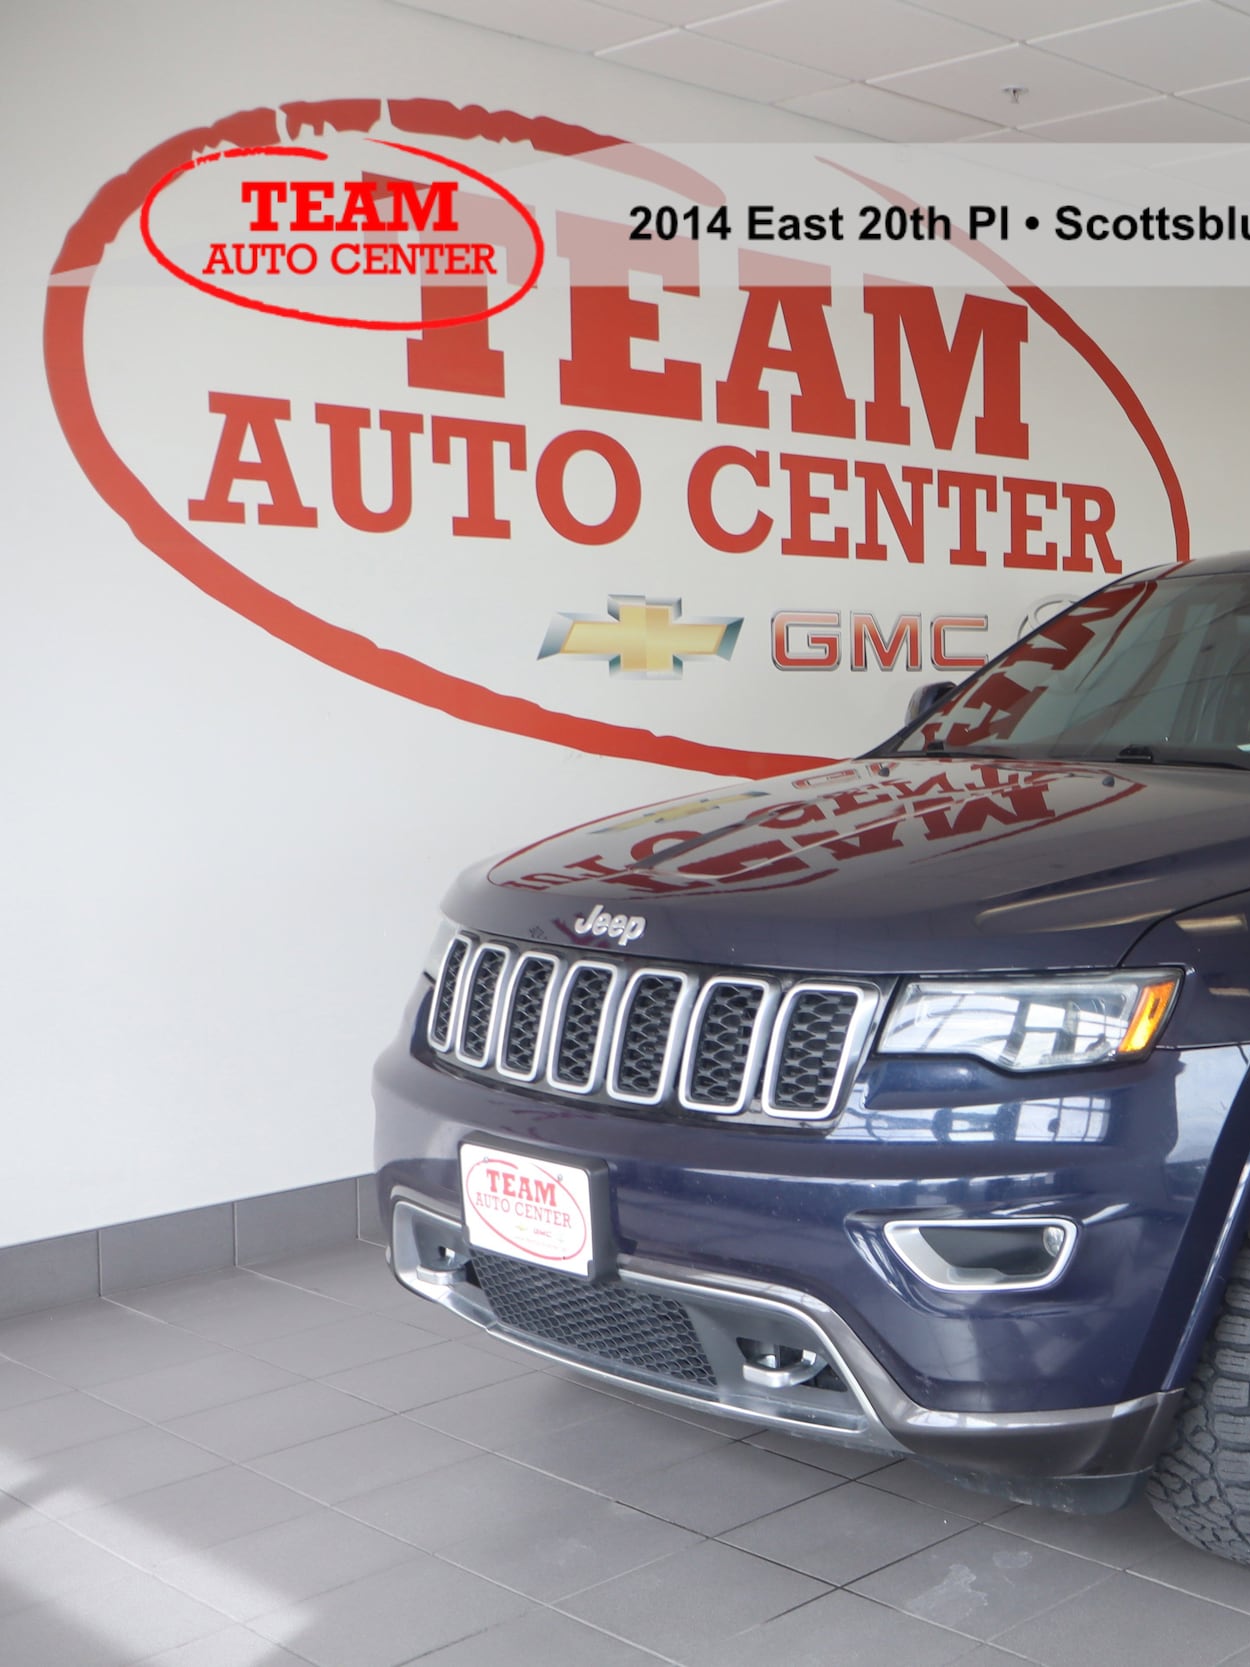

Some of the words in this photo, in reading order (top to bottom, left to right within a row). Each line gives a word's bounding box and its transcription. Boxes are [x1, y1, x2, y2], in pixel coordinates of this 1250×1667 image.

[362, 170, 1029, 460] TEAM
[188, 390, 642, 546] AUTO
[687, 445, 1122, 575] CENTER
[771, 610, 988, 672] GMC
[575, 904, 646, 946] Jeep
[476, 1192, 510, 1213] AUTO
[515, 1201, 572, 1229] CENTER
[486, 1168, 557, 1207] TEAM
